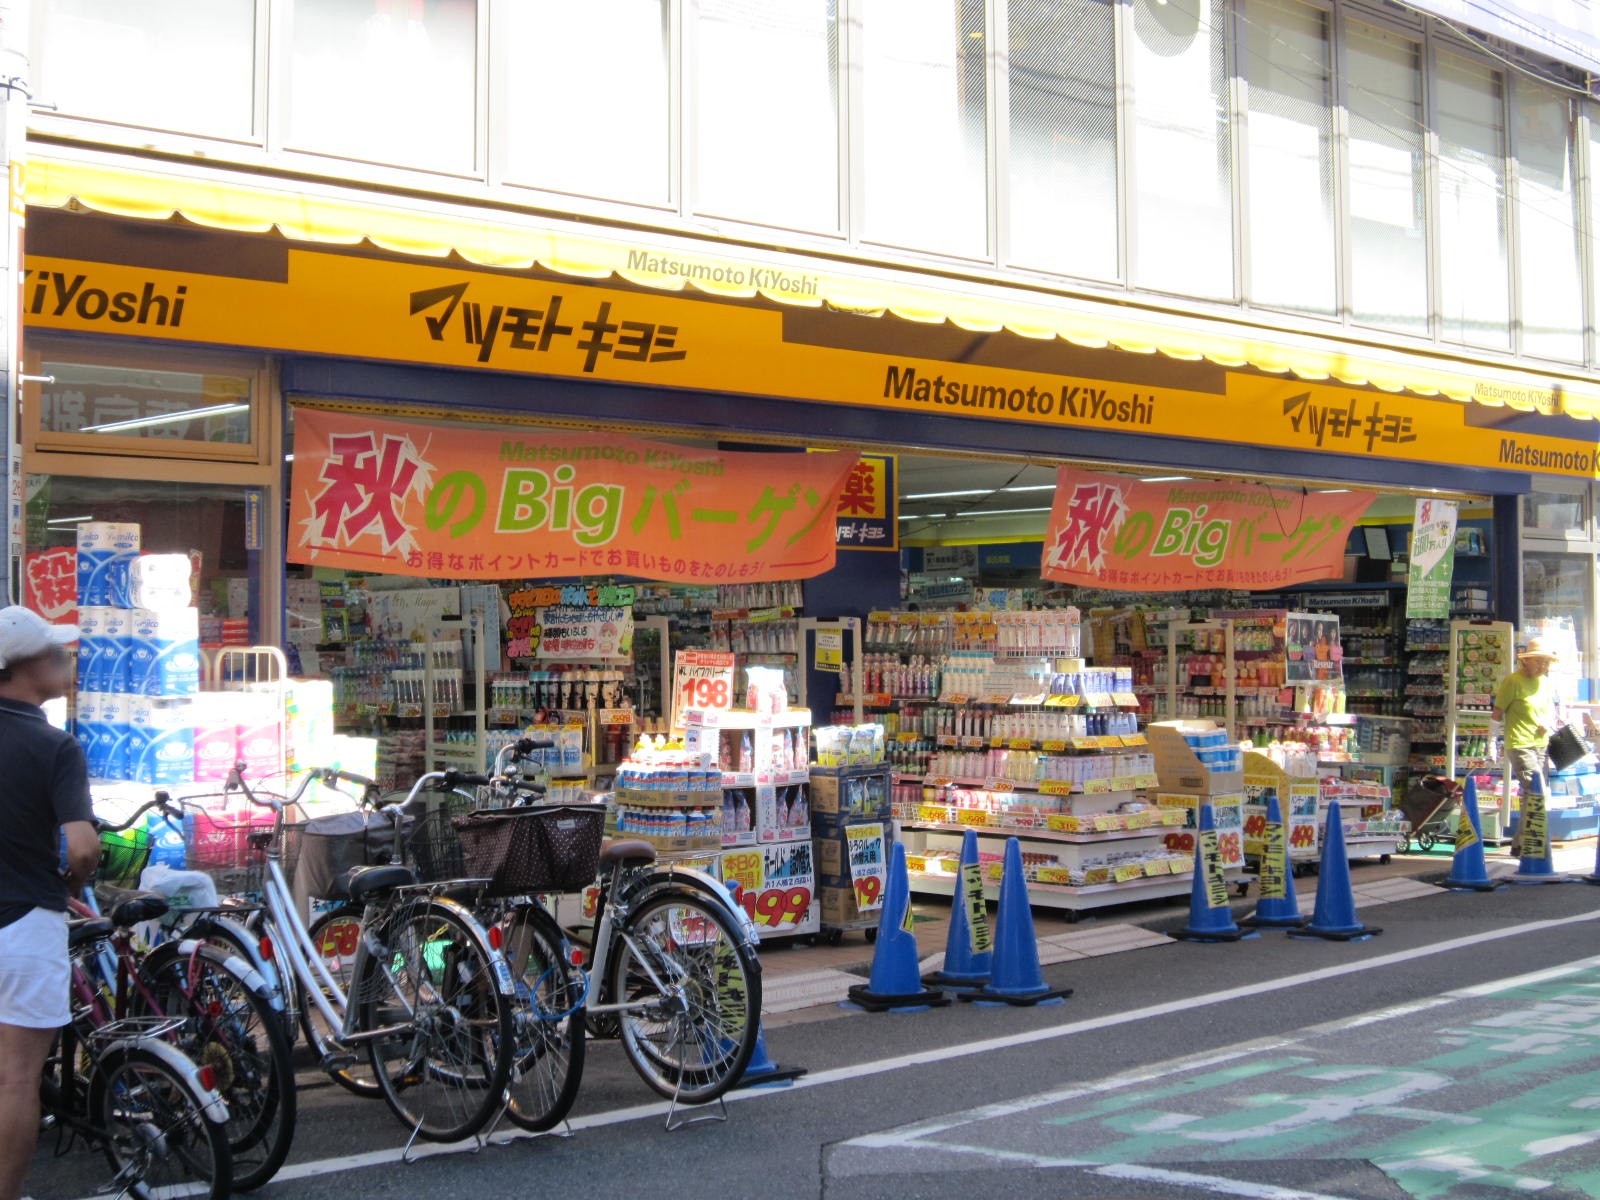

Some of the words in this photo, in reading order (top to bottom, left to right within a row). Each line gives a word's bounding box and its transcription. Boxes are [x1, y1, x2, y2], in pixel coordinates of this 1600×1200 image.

[627, 250, 745, 285] Matsumoto
[749, 267, 818, 296] KiYoshi
[24, 269, 187, 328] iYoshi
[410, 282, 687, 373] マツモトキヨシ
[883, 365, 1054, 415] Matsumoto
[1058, 386, 1154, 425] KiYoshi
[1474, 383, 1527, 403] Matsumoto
[1527, 389, 1560, 408] KiYoshi
[1283, 391, 1418, 452] マツモトキヨシ
[498, 440, 639, 466] Matsumoto
[643, 449, 725, 477] KiYoshi
[1499, 438, 1589, 472] Matsumoto
[1166, 486, 1247, 506] Matsumoto
[682, 677, 728, 708] 198
[724, 854, 759, 871] 本日の
